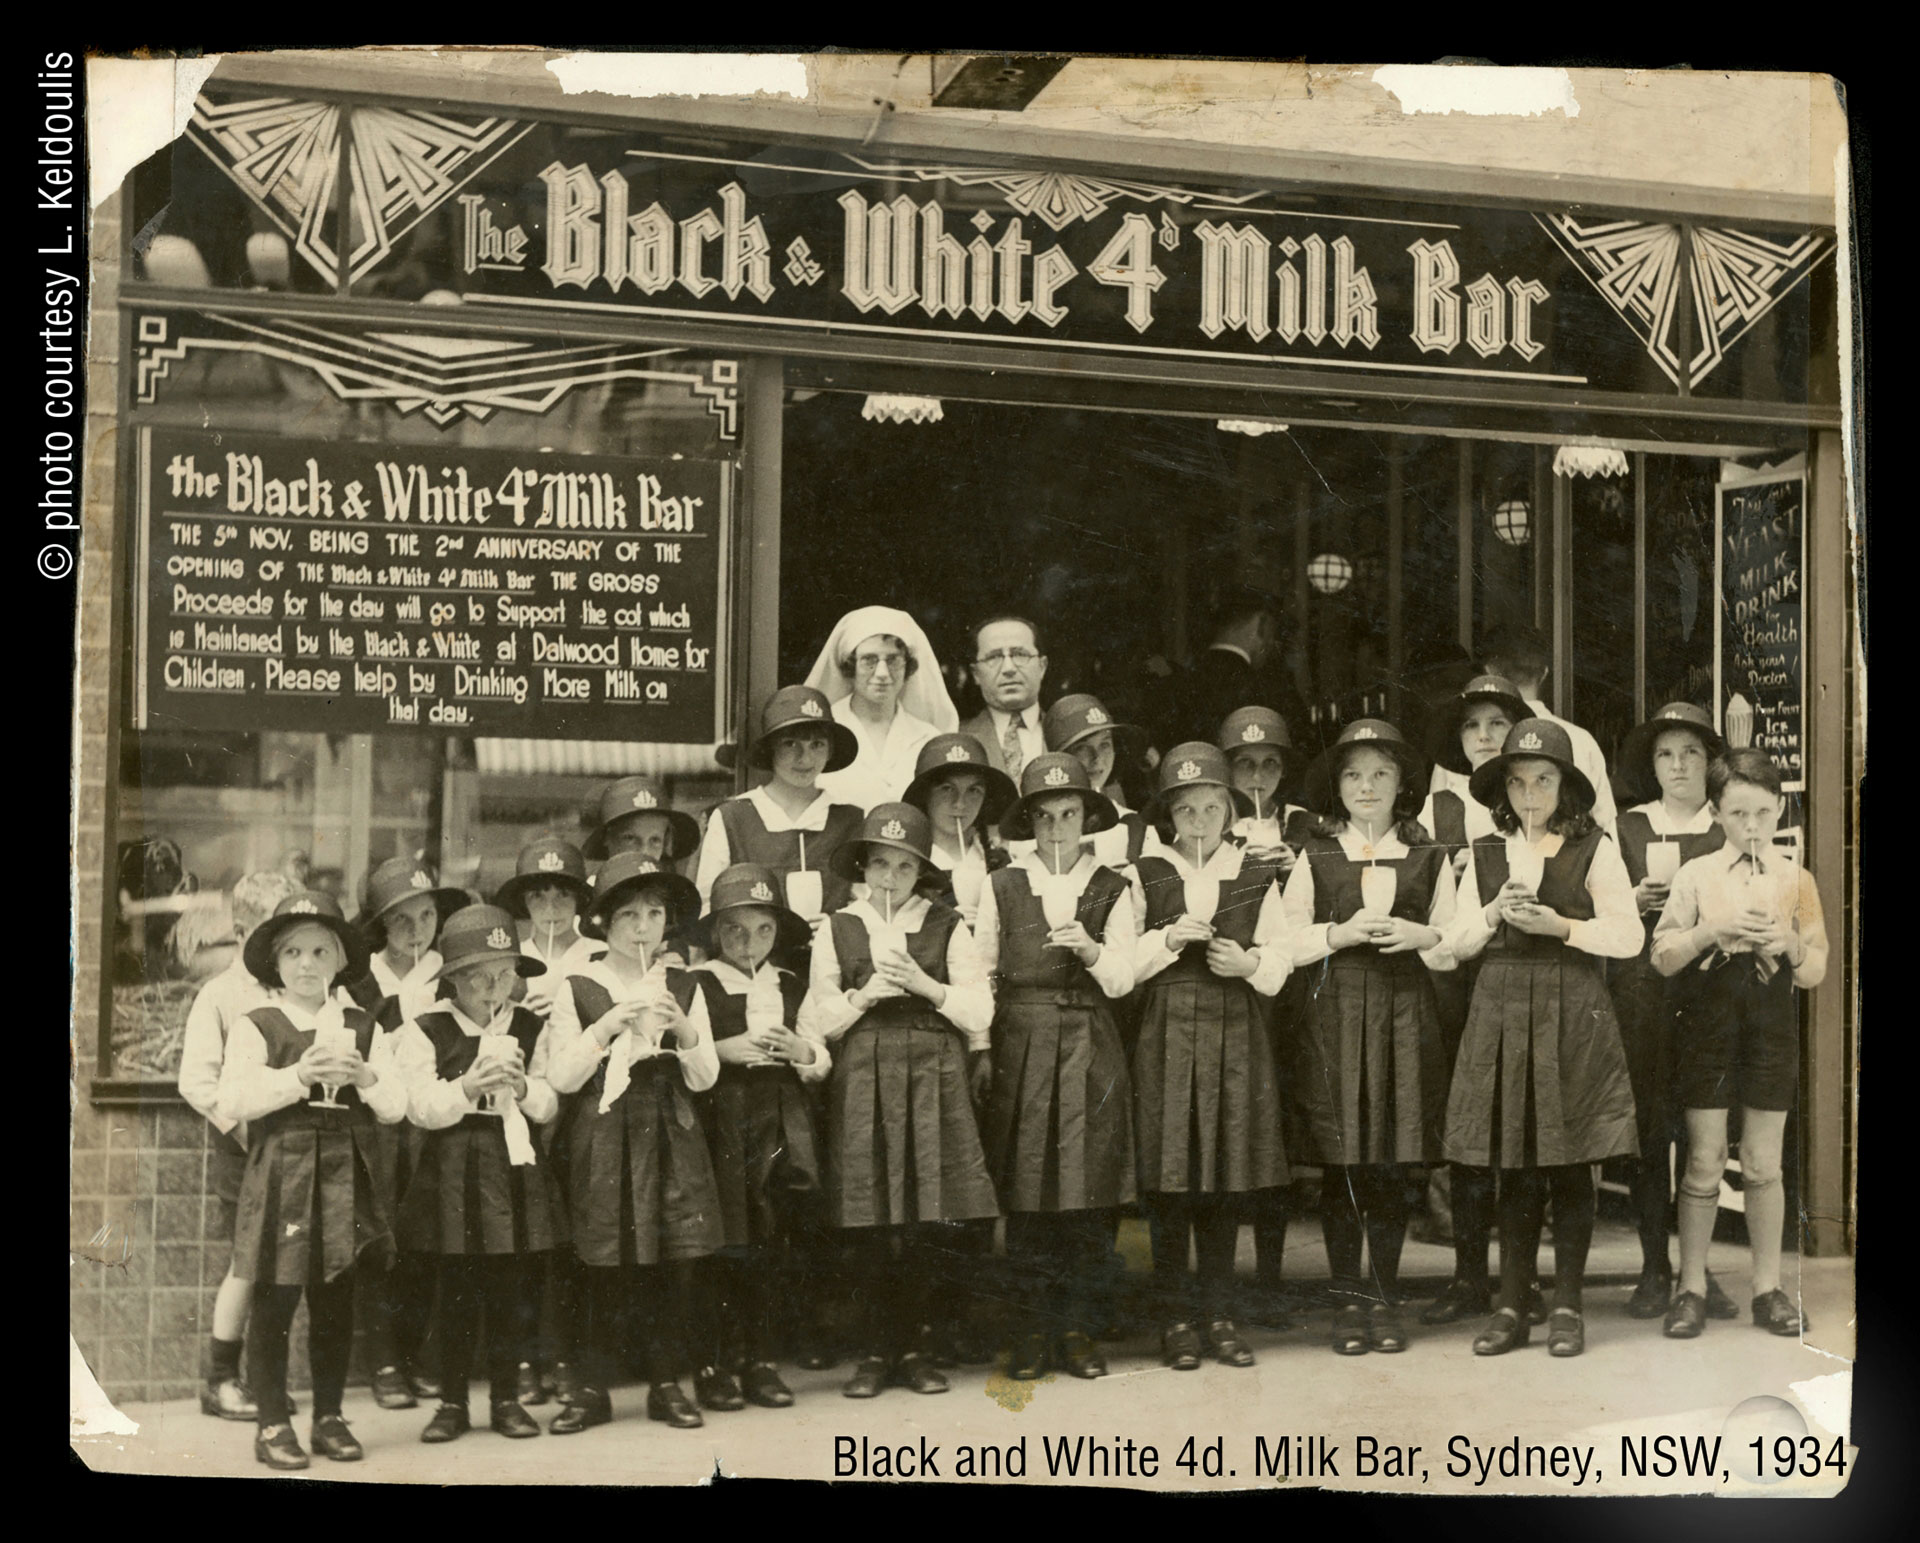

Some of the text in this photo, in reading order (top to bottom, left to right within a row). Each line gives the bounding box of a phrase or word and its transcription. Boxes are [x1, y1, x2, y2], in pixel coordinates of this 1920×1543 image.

[458, 194, 530, 275] The
[539, 160, 775, 304] Black
[784, 236, 825, 287] &
[837, 188, 1079, 328] White
[1192, 219, 1382, 351] Milk
[1405, 237, 1551, 363] Bar
[166, 454, 222, 498] the
[225, 452, 335, 518] Black
[340, 480, 372, 520] &
[375, 461, 493, 525] White
[534, 471, 628, 530] Milk
[637, 473, 704, 532] Bar
[169, 523, 682, 564] THE 5th NOV. BEING THE 2nd ANNIVERSARY OF THE
[167, 555, 245, 580] OPENING
[258, 560, 285, 582] OF
[297, 562, 325, 584] THE
[331, 563, 373, 586] Black
[388, 566, 431, 588] White
[459, 568, 500, 590] Milk
[506, 570, 536, 591] Bar
[550, 570, 578, 592] THE
[588, 572, 661, 595] GROSS
[1740, 550, 1788, 592] MILK
[173, 583, 274, 616] Proceeds
[283, 588, 308, 617] for
[319, 591, 344, 619] the
[349, 592, 385, 619] day
[396, 594, 422, 621] will
[429, 601, 456, 627] go
[497, 595, 566, 629] Support
[582, 599, 607, 626] the
[613, 602, 643, 626] cot
[648, 602, 691, 629] which
[1735, 569, 1799, 624] DRINK
[169, 629, 186, 650] is
[296, 625, 319, 655] by
[329, 628, 355, 656] the
[364, 629, 410, 658] Black
[416, 637, 431, 659] &
[431, 631, 481, 661] White
[496, 631, 517, 661] at
[532, 631, 620, 666] Dalwood
[630, 636, 680, 669] Home
[685, 638, 710, 670] for
[1743, 618, 1798, 649] Health
[265, 657, 342, 692] Please
[354, 662, 397, 699] help
[409, 664, 436, 694] by
[454, 665, 529, 705] Drinking
[543, 667, 591, 699] More
[605, 669, 641, 700] Milk
[645, 680, 668, 700] on
[1748, 670, 1788, 687] Doctor
[389, 696, 475, 723] that day.
[1770, 753, 1801, 769] DAS
